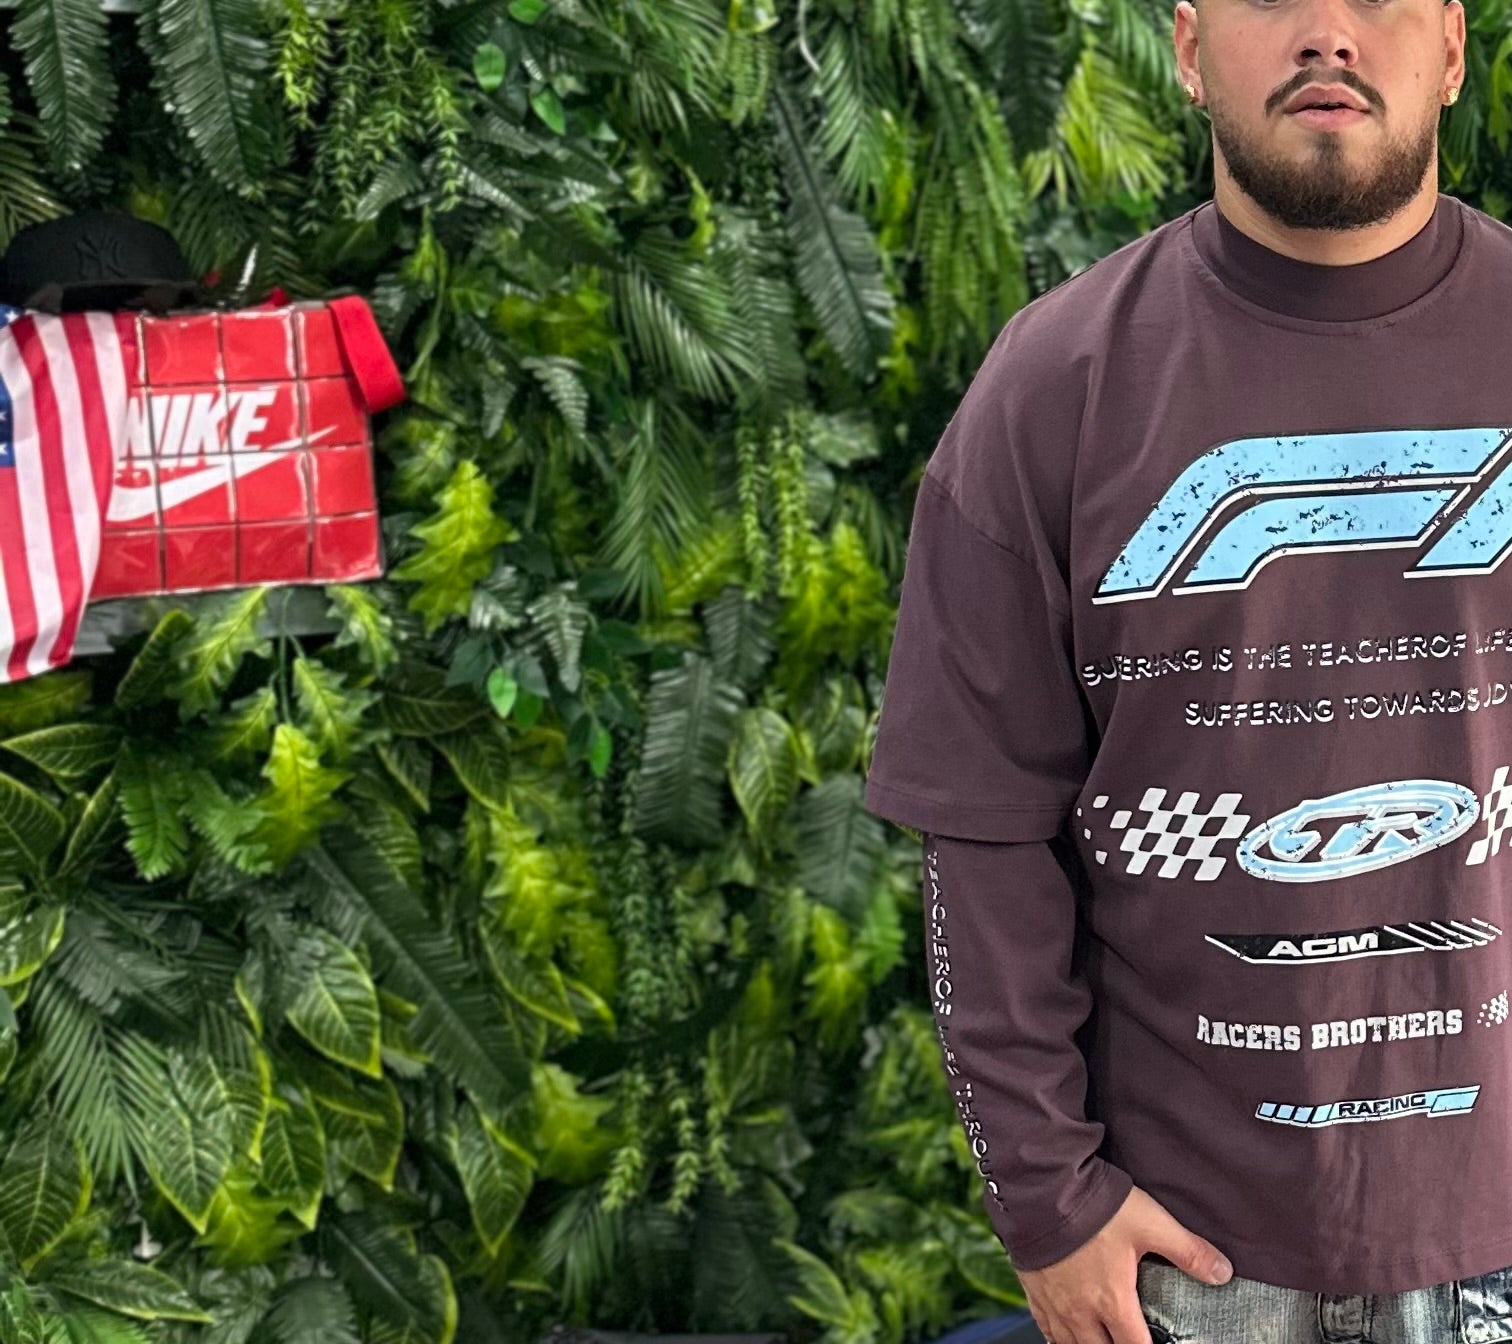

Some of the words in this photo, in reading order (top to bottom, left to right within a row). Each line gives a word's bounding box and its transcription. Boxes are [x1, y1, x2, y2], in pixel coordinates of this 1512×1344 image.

[117, 389, 278, 469] NIKE
[1212, 647, 1233, 672] IS
[1243, 644, 1292, 670] THE
[1185, 699, 1335, 727] SUFFERING
[1267, 930, 1379, 957] AGM
[1197, 1014, 1301, 1052] RACERS
[1311, 1009, 1463, 1051] BROTHERS
[1338, 1092, 1427, 1117] RACING
